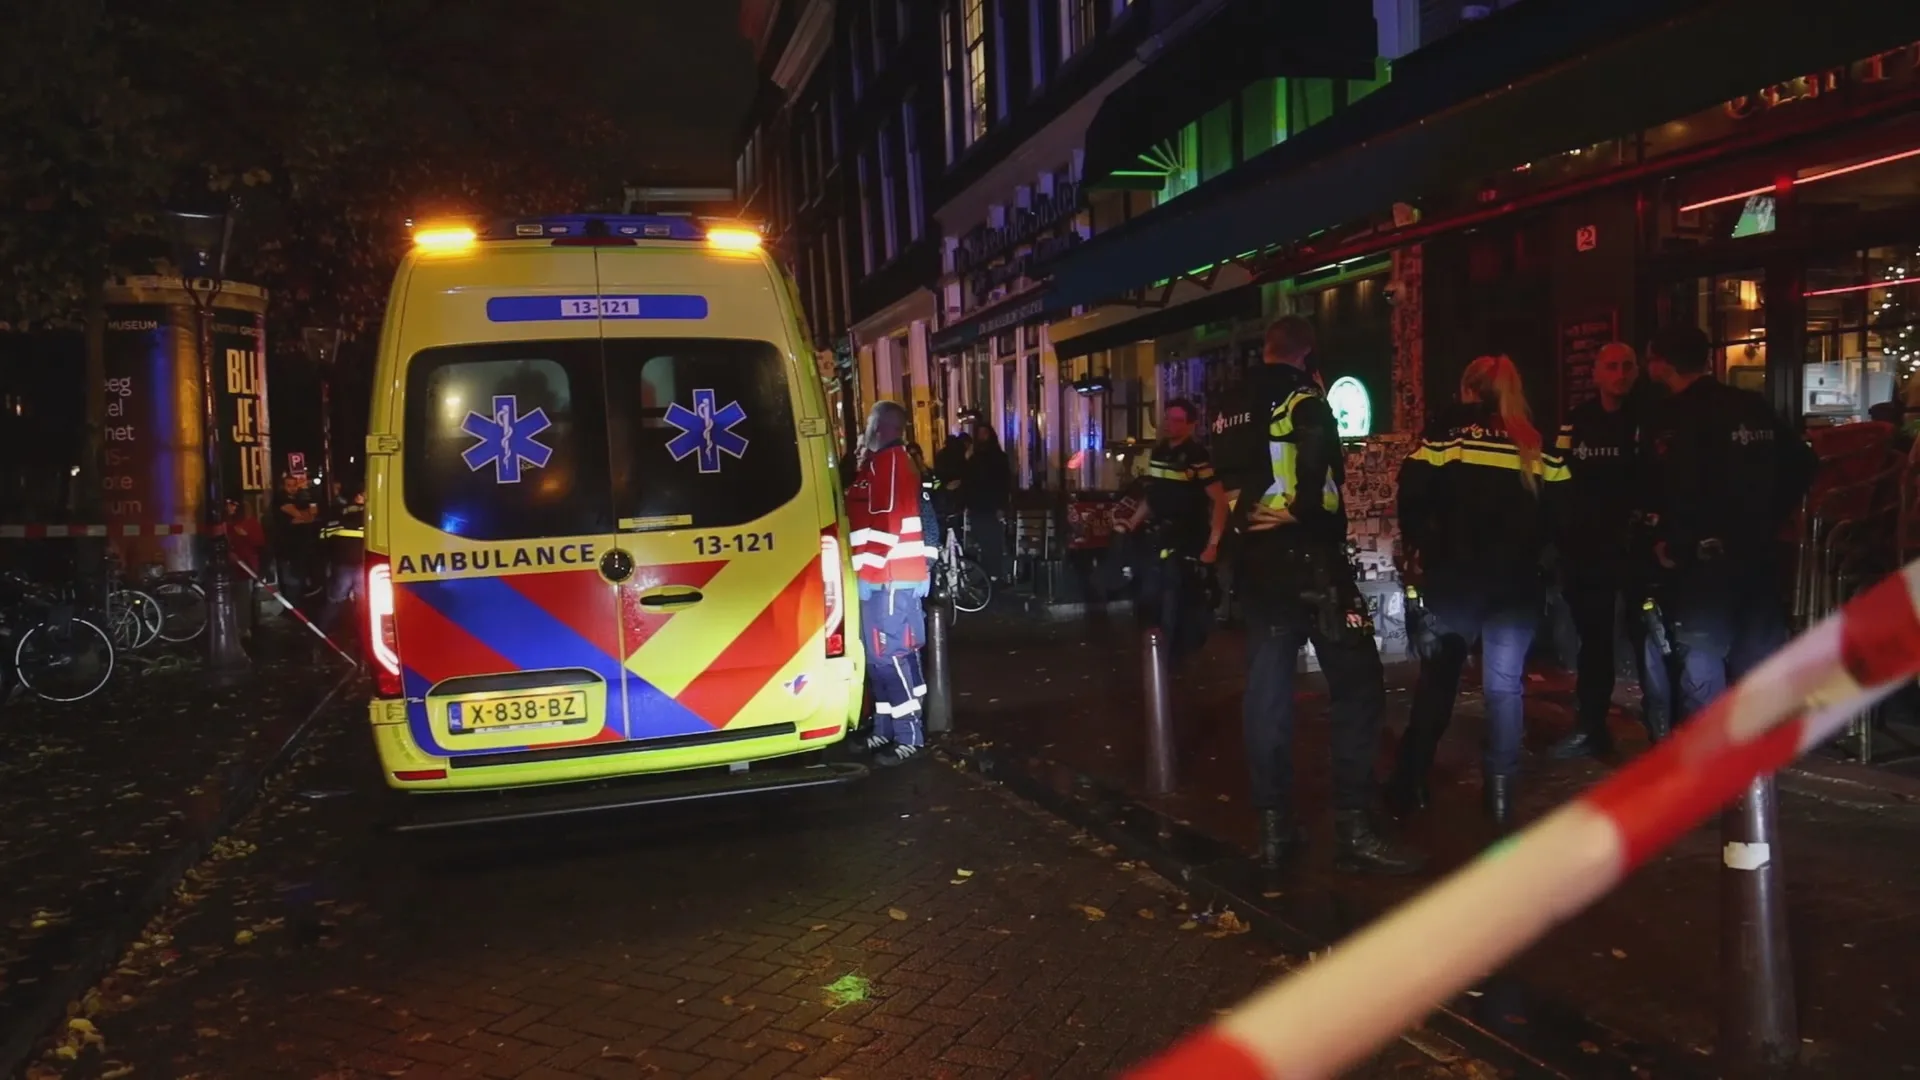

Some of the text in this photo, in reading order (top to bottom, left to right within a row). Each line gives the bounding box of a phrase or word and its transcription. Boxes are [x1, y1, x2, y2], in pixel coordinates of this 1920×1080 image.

[572, 301, 629, 313] 13-121
[108, 320, 158, 330] MUSEUM
[104, 376, 132, 397] eg
[1212, 410, 1251, 434] POLITIE
[1572, 441, 1620, 460] POLITIE
[292, 455, 301, 468] P
[693, 532, 774, 555] 13-121
[397, 543, 595, 575] AMBULANCE
[471, 697, 575, 725] X-838-BZ
